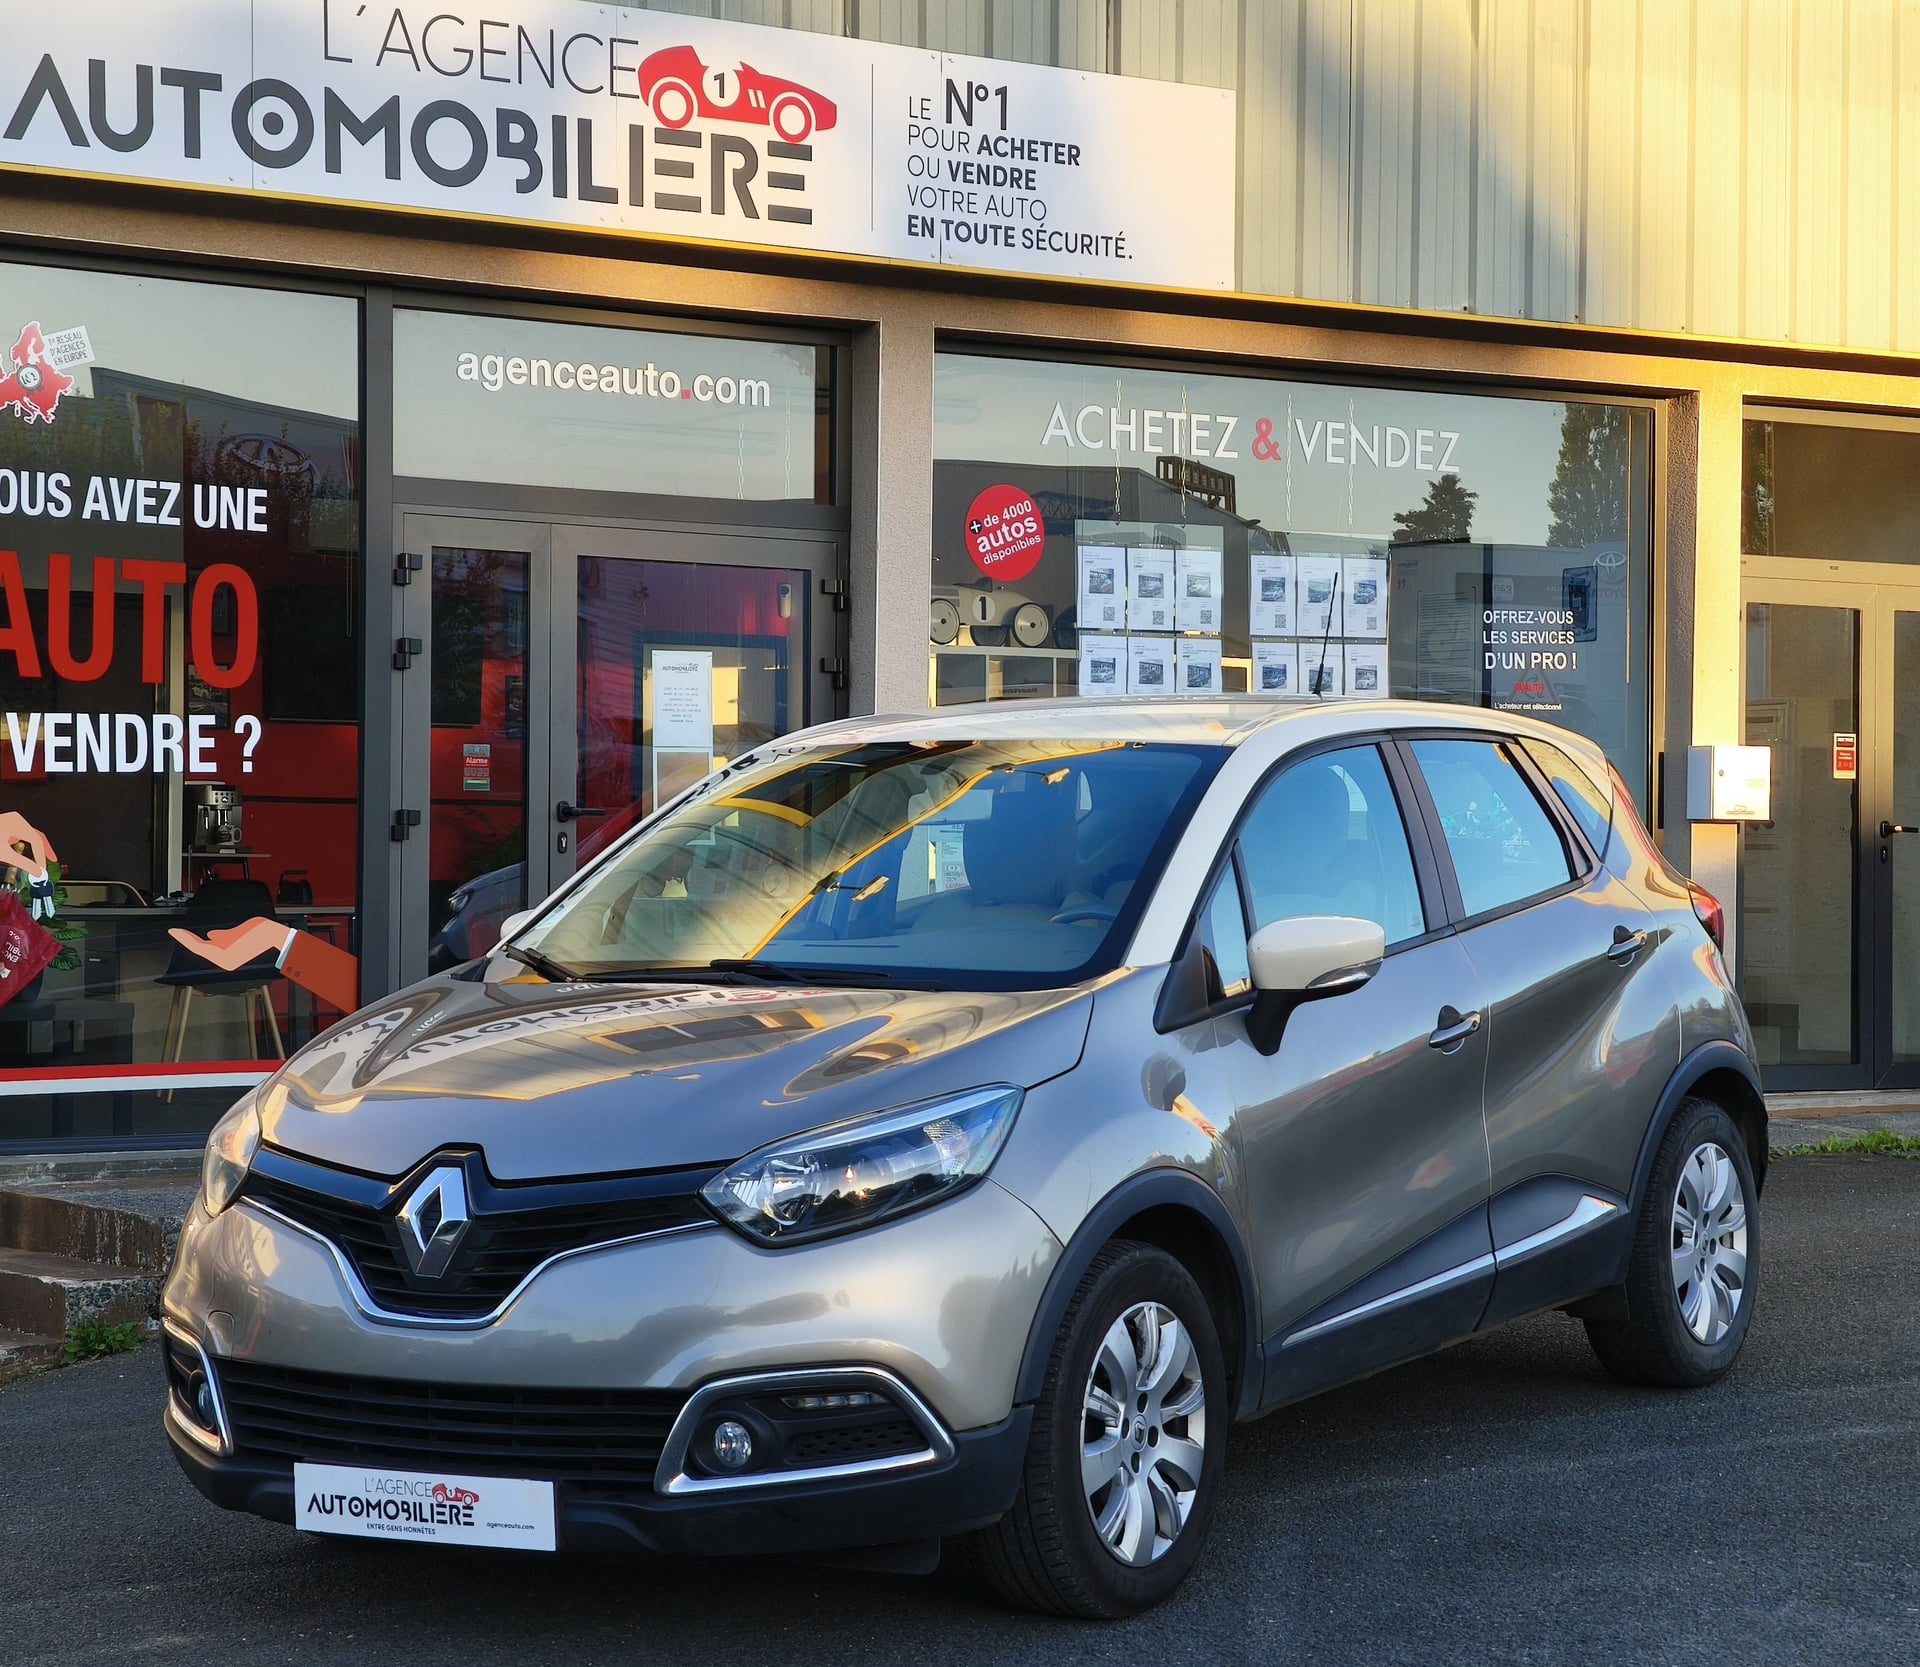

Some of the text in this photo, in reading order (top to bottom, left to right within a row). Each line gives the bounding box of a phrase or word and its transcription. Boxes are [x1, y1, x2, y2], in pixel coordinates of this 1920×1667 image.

[323, 0, 639, 99] L'AGENCE
[713, 71, 725, 99] 1
[908, 96, 931, 120] LE
[908, 124, 1081, 166] POUR ACHETER
[907, 155, 1037, 191] OU VENDRE
[907, 184, 1047, 221] VOTRE AUTO
[908, 214, 1133, 260] EN TOUTE SÉCURITÉ.
[64, 350, 88, 363] EUROPE
[456, 350, 770, 407] agenceauto.com
[1041, 401, 1461, 473] ACHETEZ & VENDEZ
[82, 476, 181, 527] AVEZ
[194, 484, 268, 532] UNE
[983, 514, 999, 528] de
[1002, 500, 1032, 520] 4000
[976, 516, 1037, 553] autos
[983, 534, 1042, 565] disponibles
[979, 596, 987, 621] 1
[1483, 610, 1574, 624] OFFREZ-VOUS
[1483, 630, 1575, 645] LES SERVICES
[1485, 652, 1578, 670] D'UN PRO !
[5, 711, 262, 773] VENDRE ?
[364, 1477, 432, 1497] L'AGENCE
[307, 1493, 475, 1526] AUTOMOBILIERE
[367, 1523, 385, 1531] ENTRE
[386, 1524, 403, 1532] GENS
